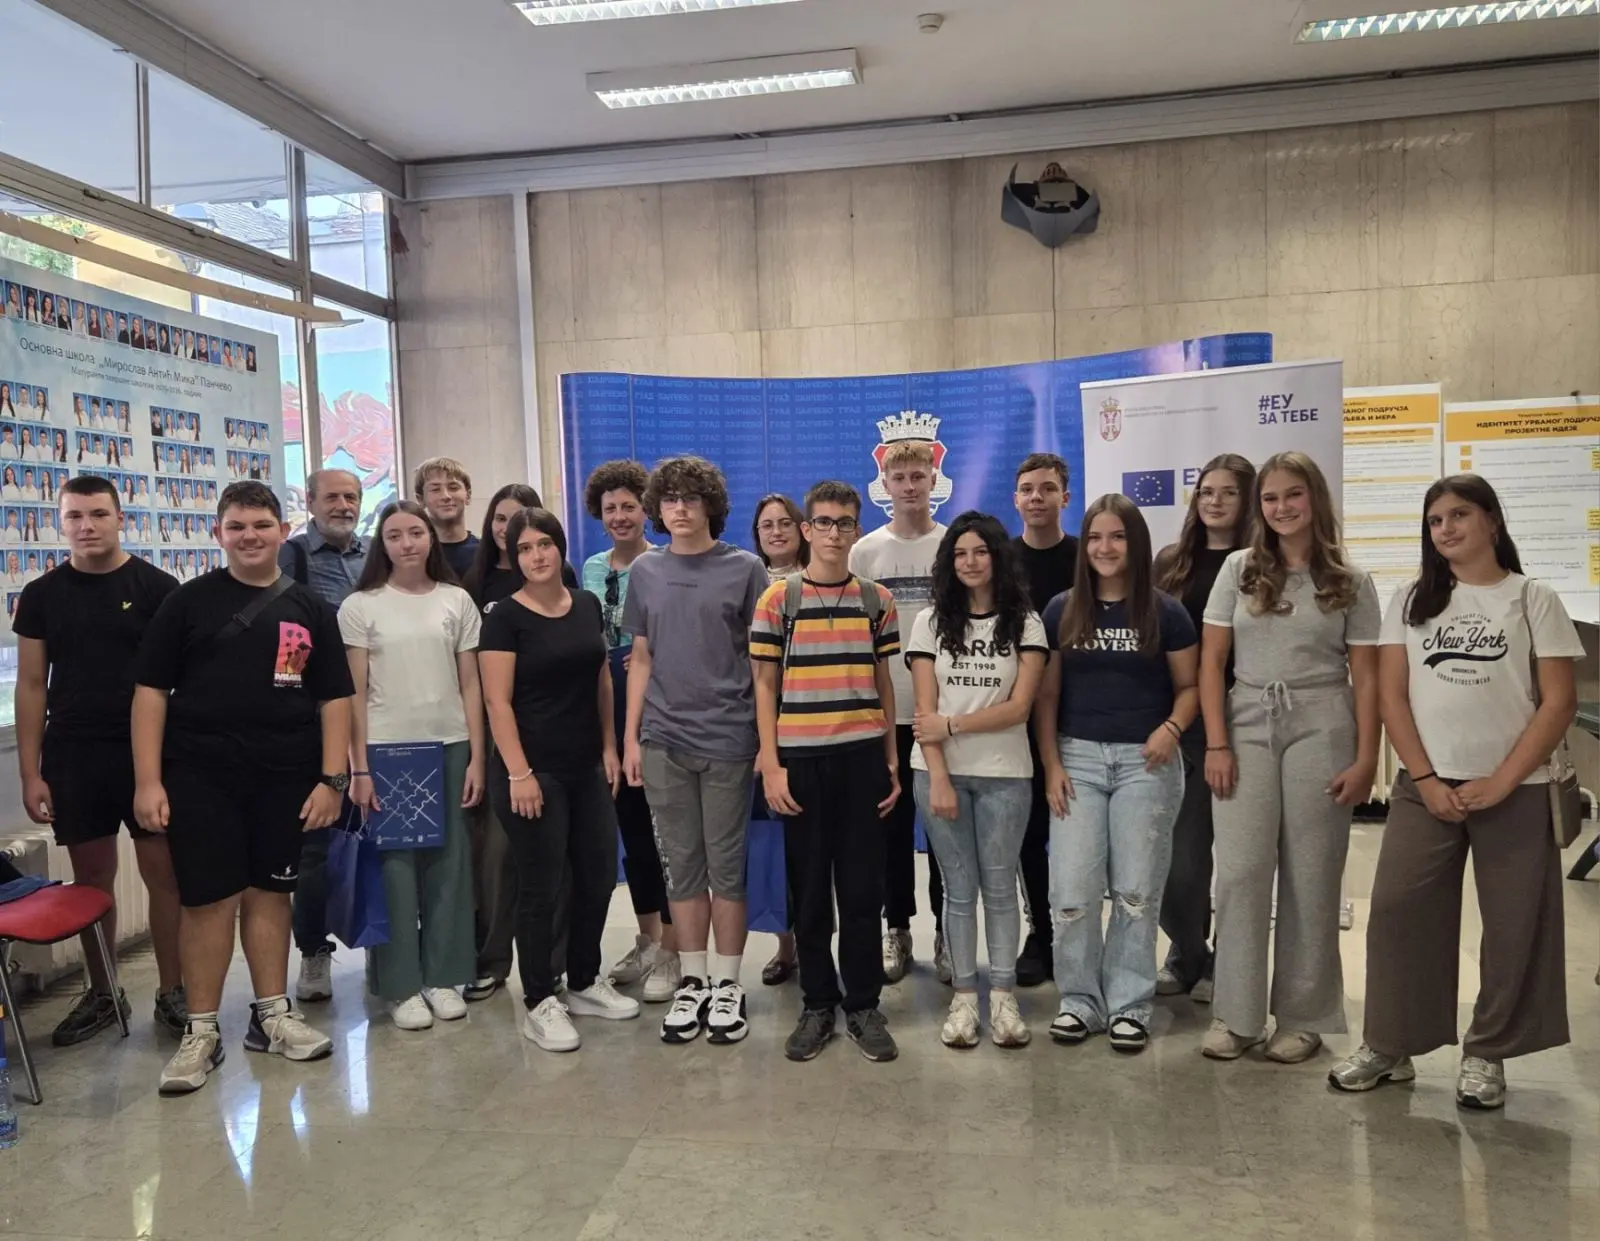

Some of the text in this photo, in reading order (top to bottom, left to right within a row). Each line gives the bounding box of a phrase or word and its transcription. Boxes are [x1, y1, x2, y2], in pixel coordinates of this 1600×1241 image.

[20, 337, 63, 358] Основна
[148, 366, 172, 381] Антић
[200, 376, 233, 392] Панчево
[1258, 393, 1293, 411] #ЕУ
[1368, 405, 1409, 413] ПОДРУЧЈА
[1258, 408, 1318, 424] ЗА ТЕБЕ
[1476, 420, 1522, 428] ИДЕНТИТЕТ
[1423, 626, 1508, 652] New York
[952, 661, 970, 669] EST
[947, 676, 1001, 687] ATELIER
